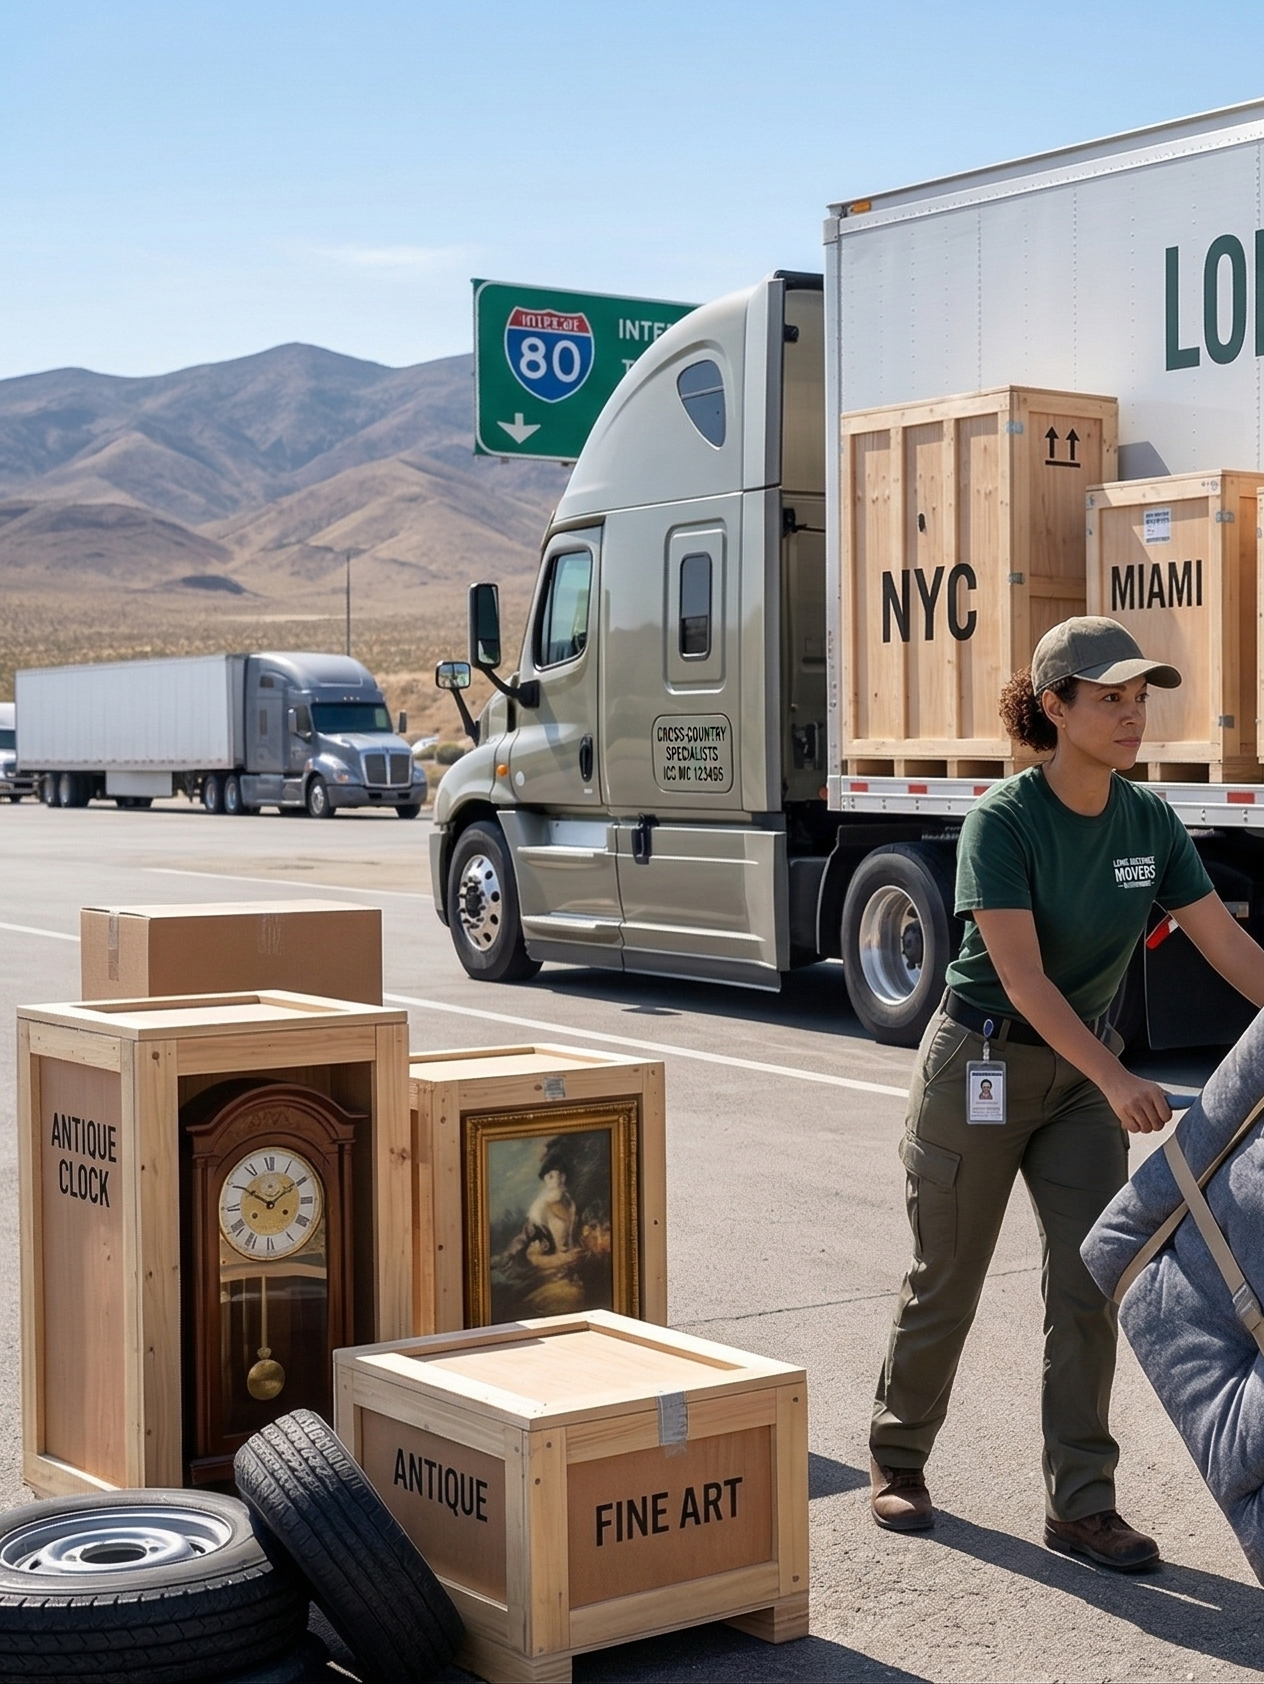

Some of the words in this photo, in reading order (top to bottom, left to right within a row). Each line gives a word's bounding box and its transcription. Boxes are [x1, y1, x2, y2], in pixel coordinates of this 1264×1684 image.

[618, 318, 674, 341] INTE
[519, 336, 581, 383] 80
[882, 562, 978, 644] NYC
[1111, 559, 1203, 612] MIAMI
[1114, 864, 1156, 883] MOVERS
[50, 1112, 117, 1163] ANTIQUE
[58, 1158, 111, 1208] CLOCK
[393, 1447, 488, 1523] ANTIQUE
[595, 1491, 670, 1547] FINE
[679, 1476, 743, 1529] ART
